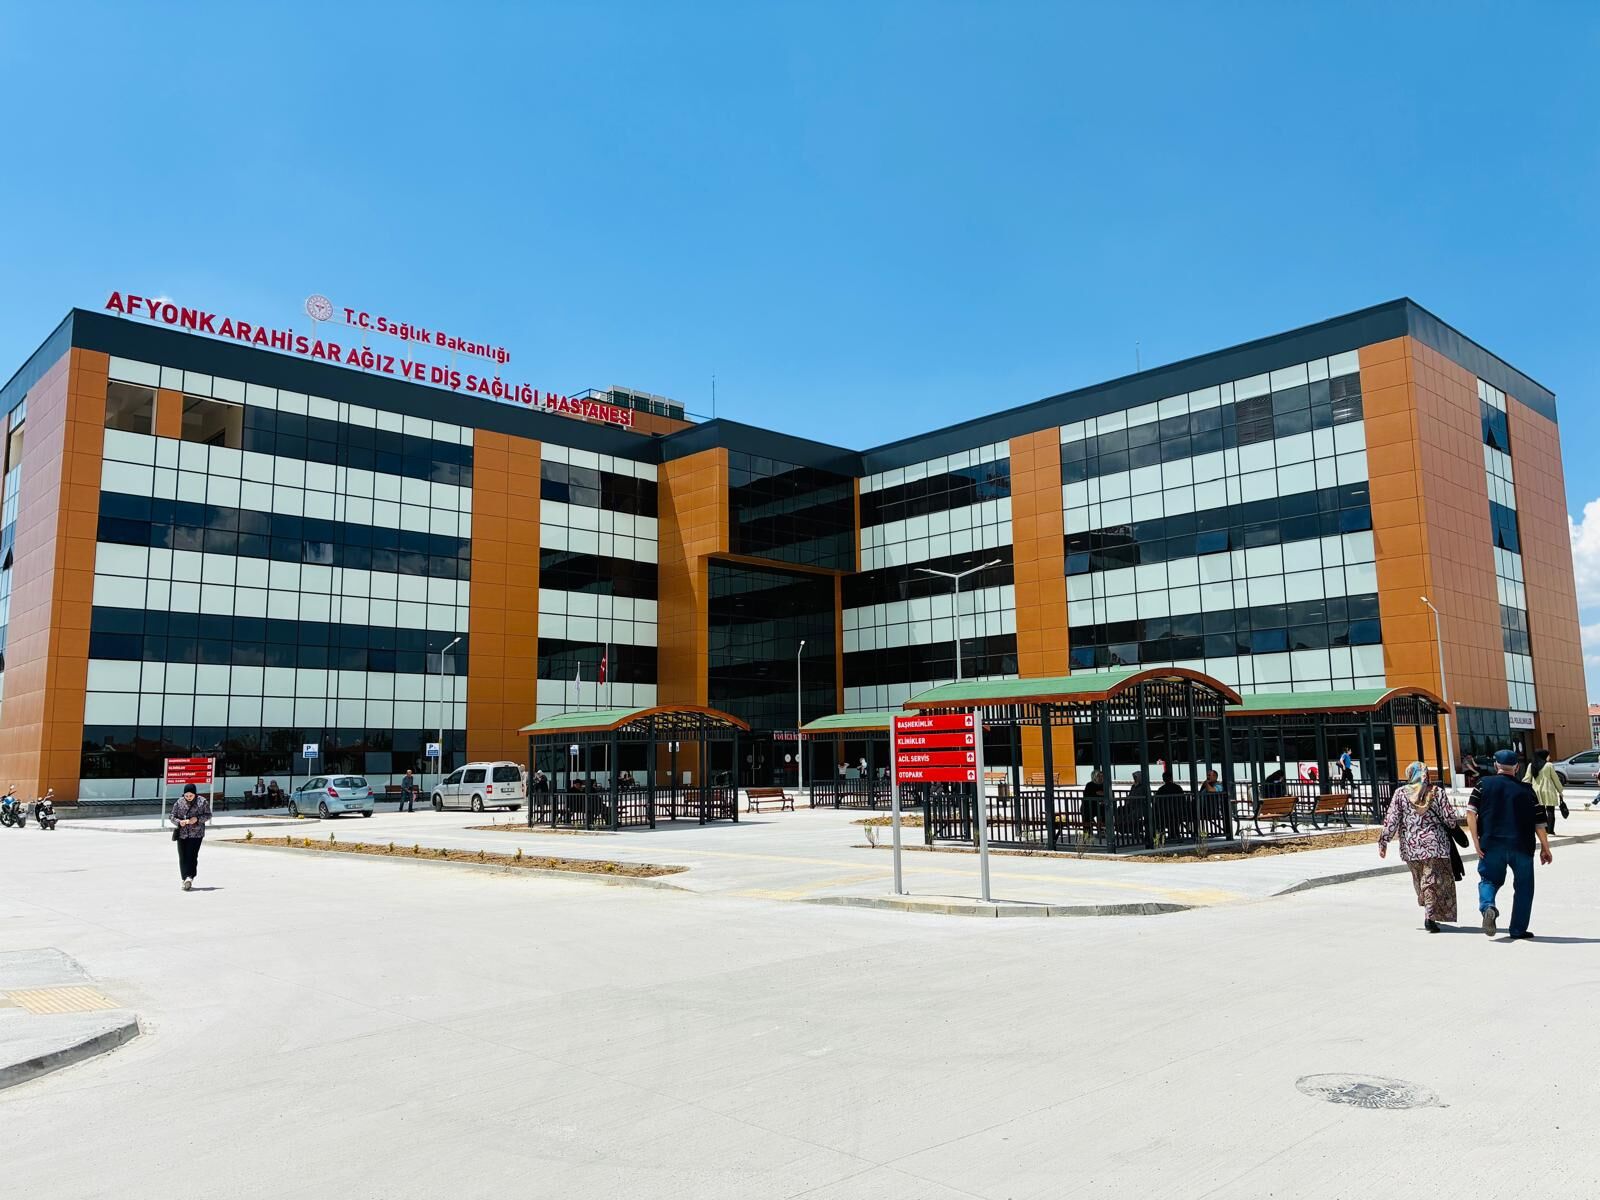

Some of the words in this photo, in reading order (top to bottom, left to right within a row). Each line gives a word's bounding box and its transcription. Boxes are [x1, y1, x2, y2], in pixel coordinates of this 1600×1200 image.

[344, 308, 375, 330] T.C.
[377, 317, 431, 343] Sağlık
[436, 332, 511, 365] Bakanlığı
[106, 291, 342, 362] AFYONKARAHİSAR
[346, 347, 395, 374] AĞIZ
[400, 359, 426, 381] VE
[431, 364, 461, 390] DİŞ
[466, 374, 539, 406] SAĞLIĞI
[898, 737, 926, 745] KLİNİKLER
[898, 755, 910, 763] ACİL
[911, 754, 930, 762] SERVİS
[898, 771, 923, 779] OTOPARK
